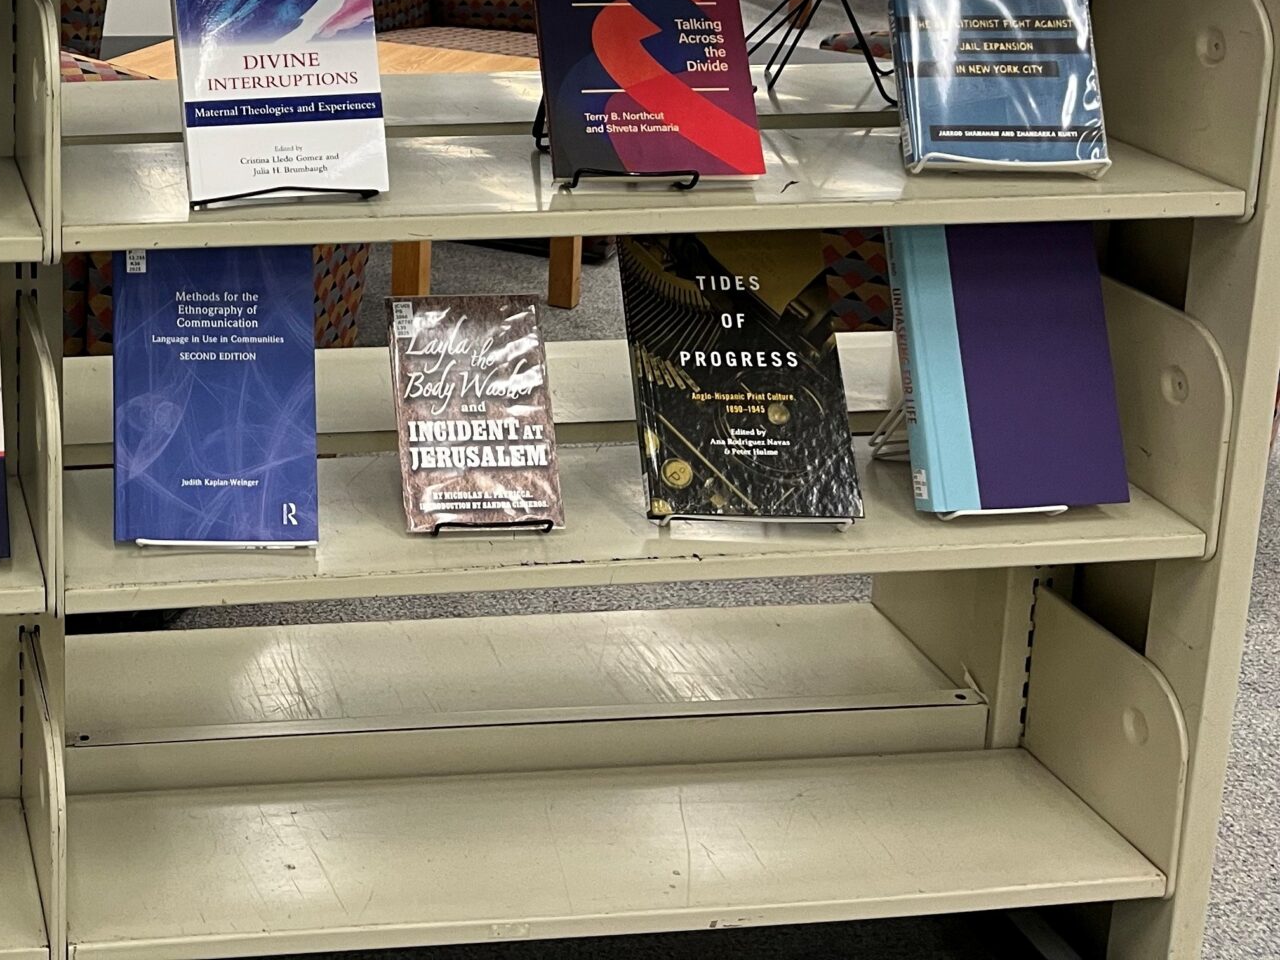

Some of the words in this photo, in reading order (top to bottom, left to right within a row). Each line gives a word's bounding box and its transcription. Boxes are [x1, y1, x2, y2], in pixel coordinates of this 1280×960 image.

[674, 19, 722, 32] Talking
[679, 33, 724, 44] Across
[704, 46, 726, 58] the
[960, 42, 981, 52] JAIL
[983, 41, 1034, 51] EXPANSION
[243, 52, 321, 71] DIVINE
[686, 60, 729, 72] Divide
[956, 65, 967, 74] IN
[969, 65, 991, 74] NEW
[993, 65, 1020, 74] YORK
[1022, 64, 1043, 74] CITY
[207, 71, 358, 91] INTERRUPTIONS
[195, 106, 239, 119] Maternal
[242, 103, 294, 117] Theologies
[297, 102, 315, 113] and
[318, 100, 376, 115] Experiences
[584, 112, 609, 124] Terry
[622, 111, 665, 121] Northcut
[696, 275, 761, 291] TIDES
[175, 291, 220, 302] Methods
[223, 291, 239, 302] for
[242, 291, 259, 302] the
[178, 304, 243, 317] Ethnography
[246, 304, 258, 315] of
[176, 317, 259, 329] Communication
[721, 313, 746, 328] OF
[405, 315, 471, 374] Layla
[179, 352, 217, 361] SECOND
[219, 352, 257, 361] EDITION
[680, 351, 799, 367] PROGRESS
[404, 359, 457, 415] Body
[461, 402, 486, 413] and
[408, 417, 520, 442] INCIDENT
[522, 424, 544, 440] AT
[409, 445, 549, 471] JERUSALEM
